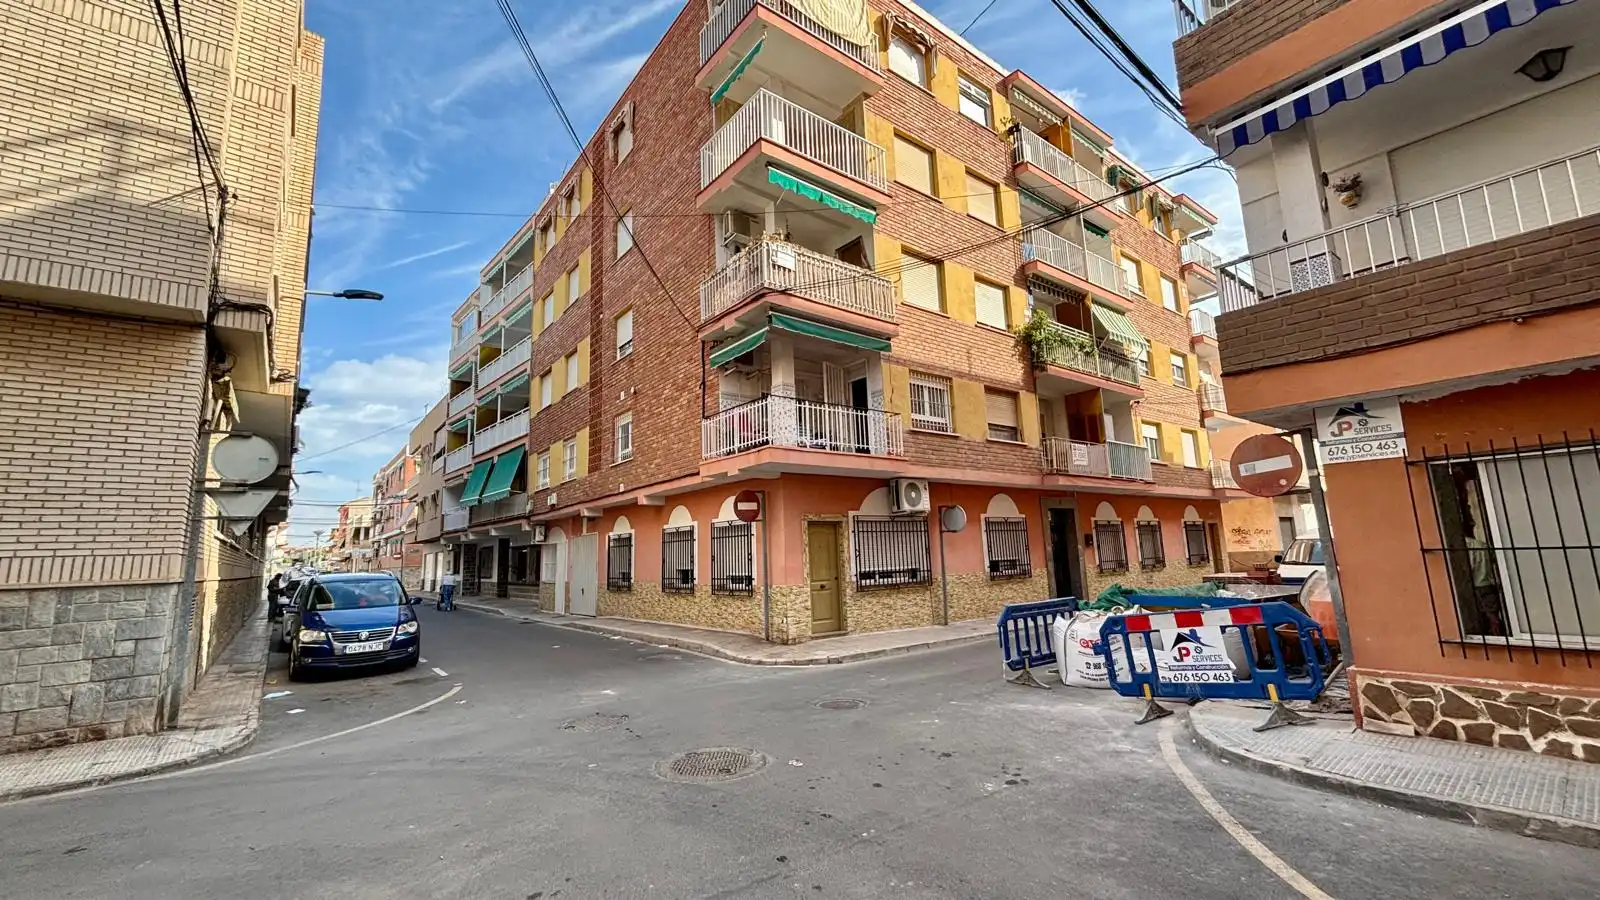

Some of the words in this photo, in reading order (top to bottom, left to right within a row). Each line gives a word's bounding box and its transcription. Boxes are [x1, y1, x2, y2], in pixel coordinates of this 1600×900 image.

[1330, 420, 1353, 437] JP
[1353, 424, 1392, 436] SERVICES
[1327, 446, 1348, 457] 676
[1351, 443, 1373, 454] 150
[1376, 440, 1398, 451] 463
[1173, 646, 1191, 662] JP
[1192, 654, 1224, 663] SERVICES
[1173, 672, 1190, 682] 676
[1191, 672, 1210, 682] 150
[1212, 672, 1231, 682] 463
